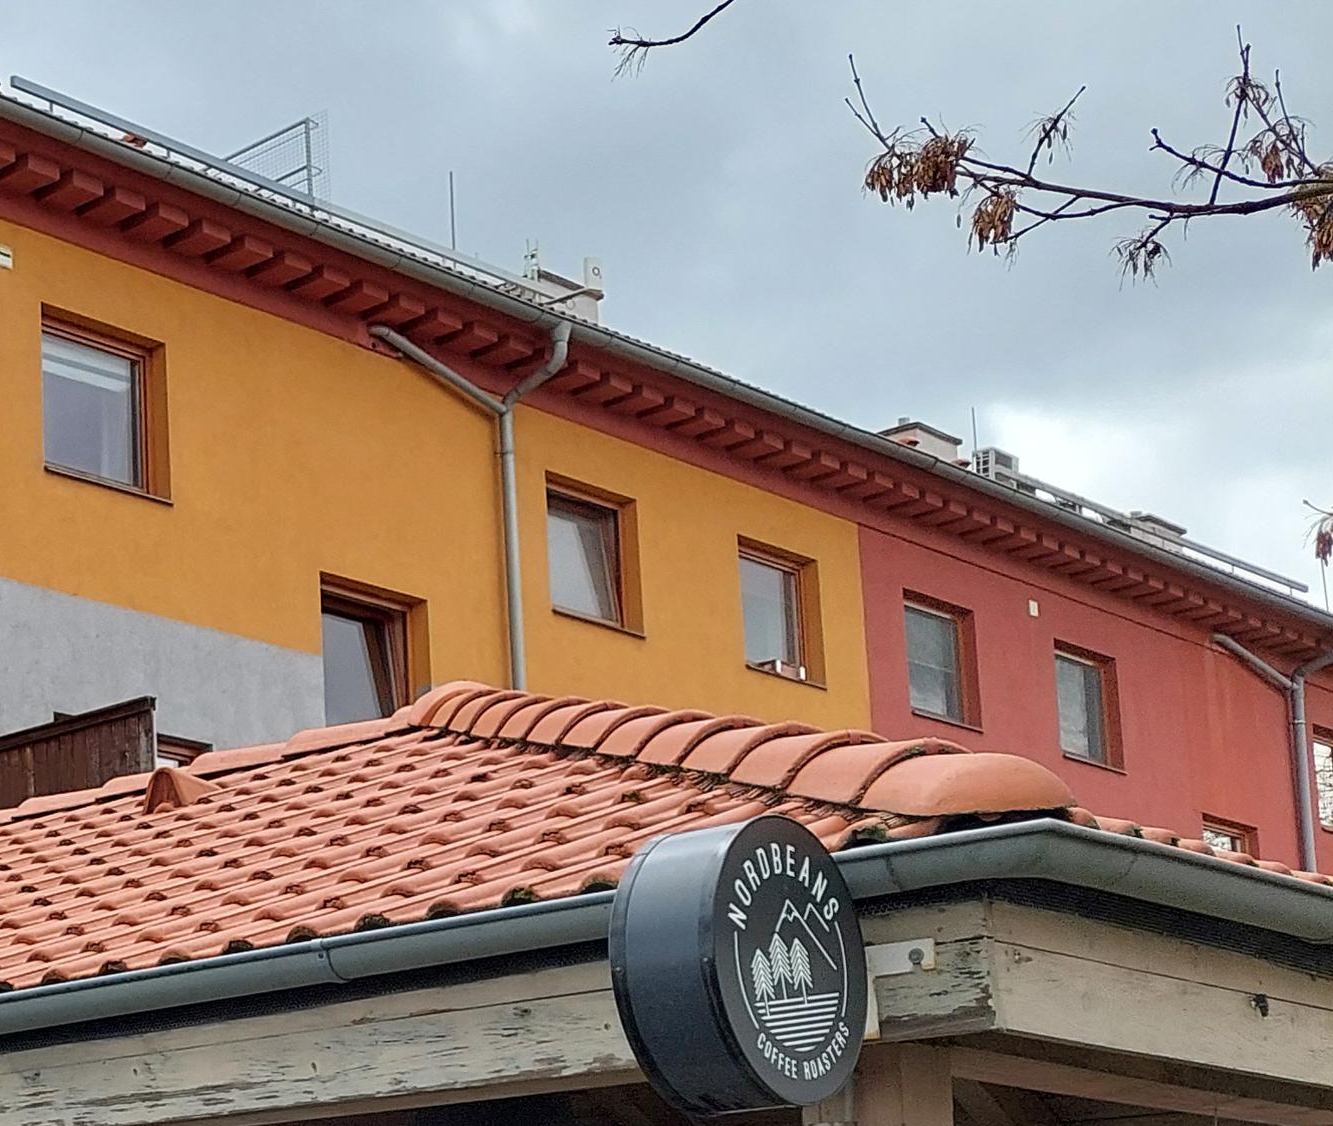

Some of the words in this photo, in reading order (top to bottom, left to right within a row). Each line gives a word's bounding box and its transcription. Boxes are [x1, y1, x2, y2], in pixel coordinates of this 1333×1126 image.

[728, 842, 839, 929] NORDBEANS
[757, 1032, 798, 1080] COFFEE
[803, 1021, 850, 1081] ROASTERS
